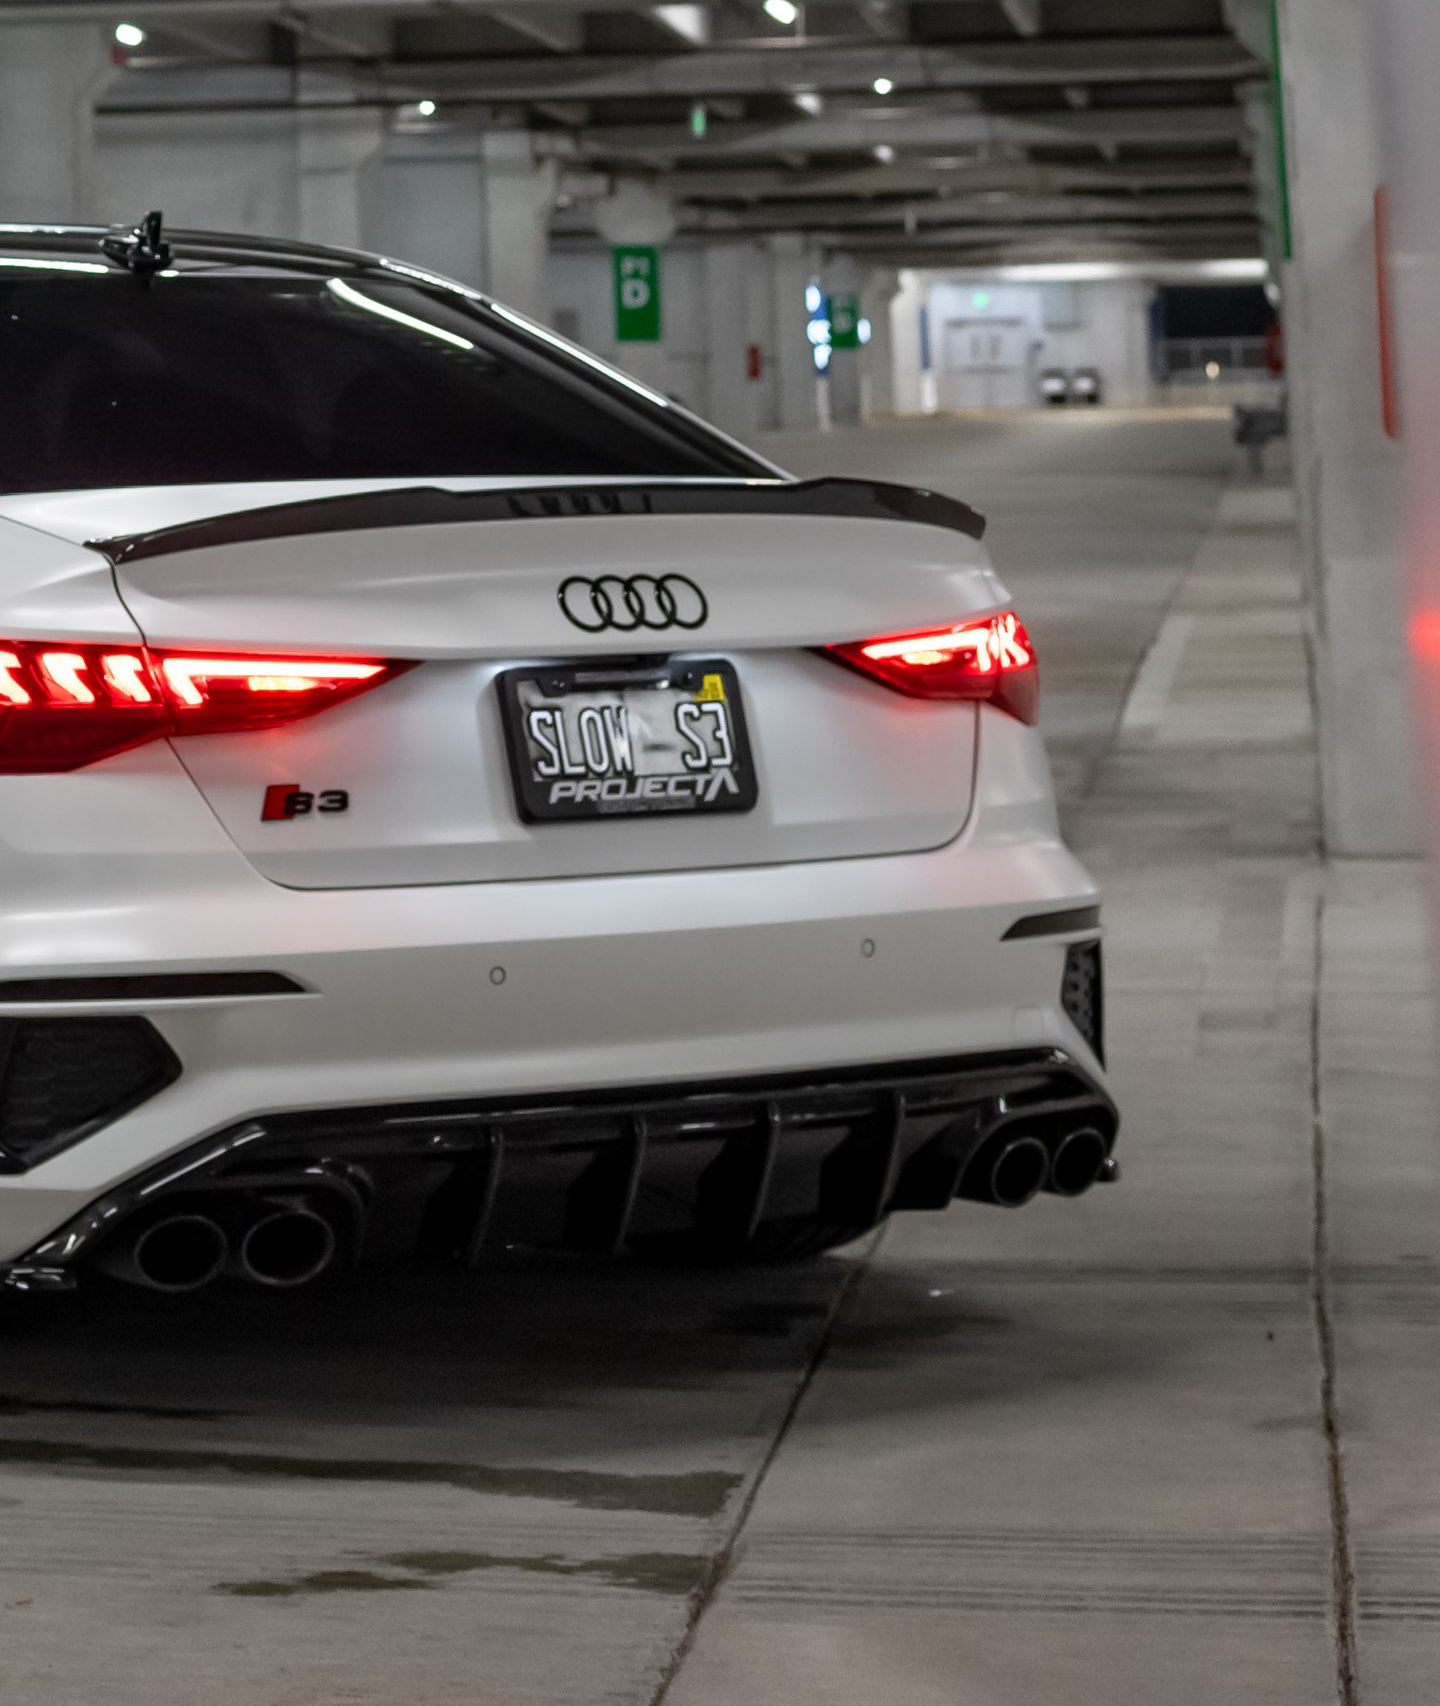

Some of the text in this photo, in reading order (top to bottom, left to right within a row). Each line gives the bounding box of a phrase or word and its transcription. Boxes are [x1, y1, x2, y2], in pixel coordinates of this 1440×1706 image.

[621, 279, 650, 309] D
[530, 700, 734, 777] SLOW S3
[282, 789, 350, 816] S3
